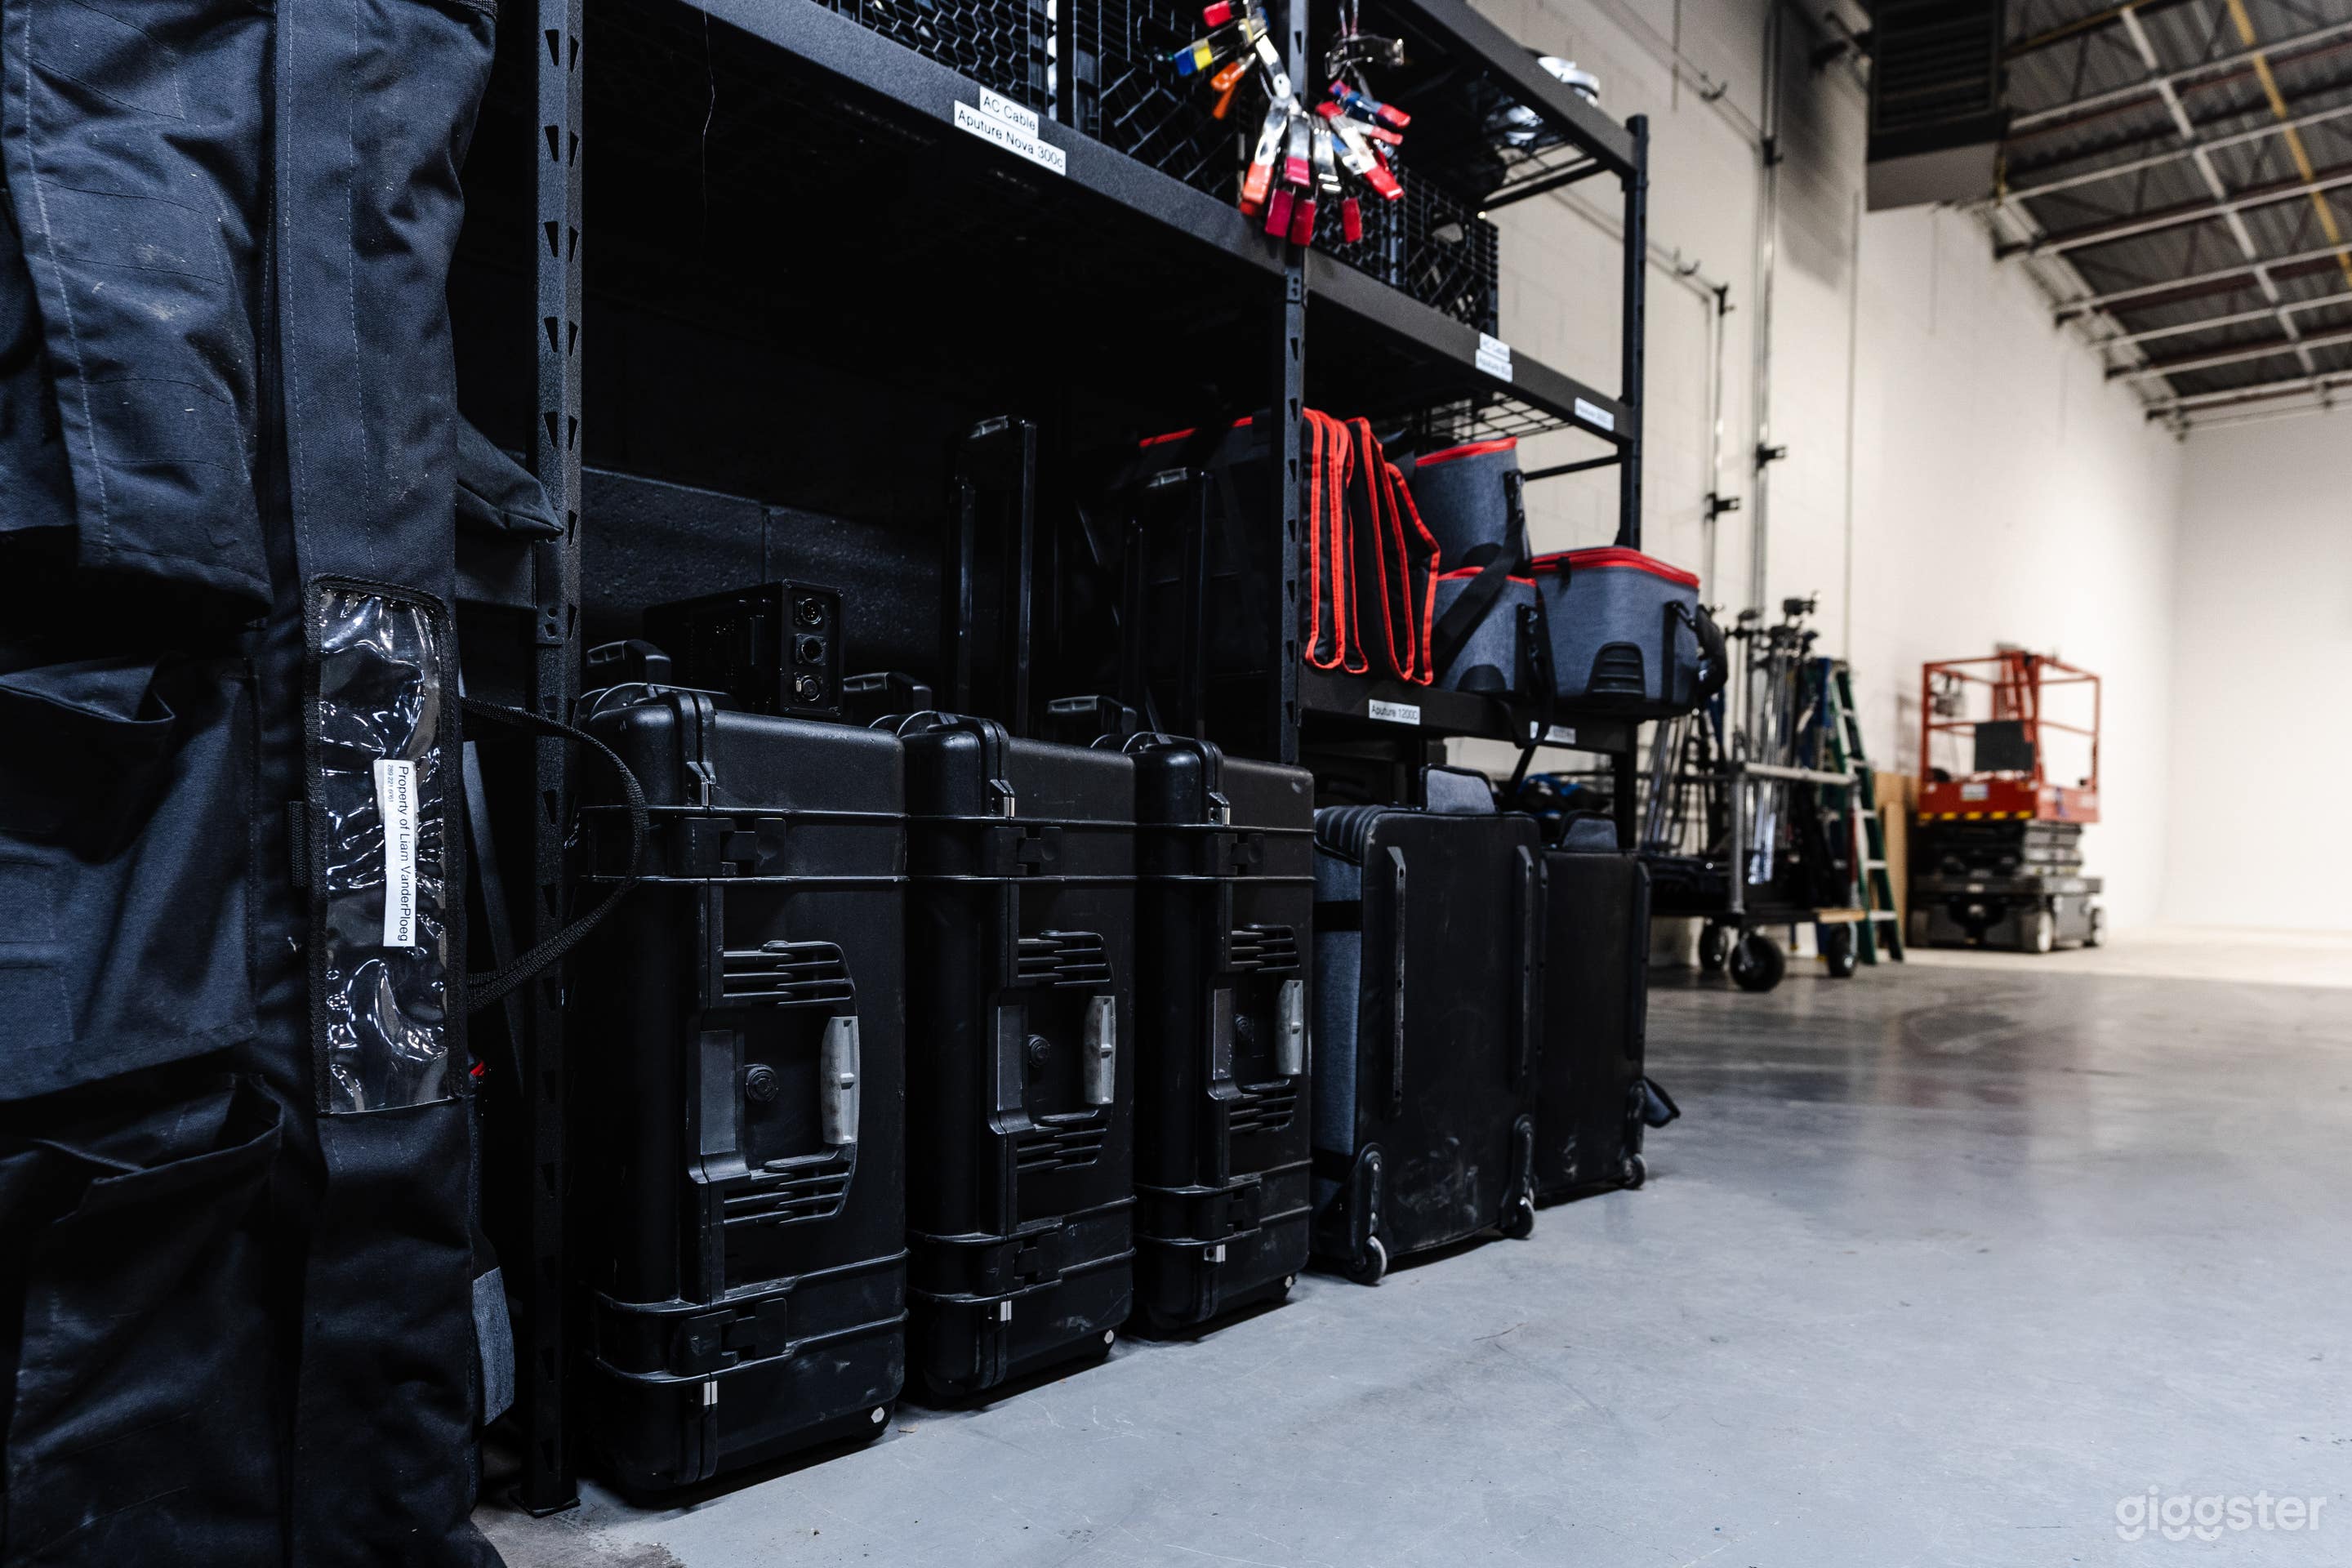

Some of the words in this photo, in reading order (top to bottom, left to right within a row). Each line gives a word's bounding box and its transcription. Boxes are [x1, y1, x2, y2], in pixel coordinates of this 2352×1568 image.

[983, 96, 1000, 113] AC
[1004, 105, 1036, 131] Cable
[958, 109, 1002, 140] Aputure
[1006, 131, 1034, 154] Nova
[1037, 145, 1063, 168] 300c
[397, 765, 410, 815] Property
[399, 818, 410, 831] of
[399, 833, 411, 862] Liam
[398, 866, 412, 942] VanderPloeg
